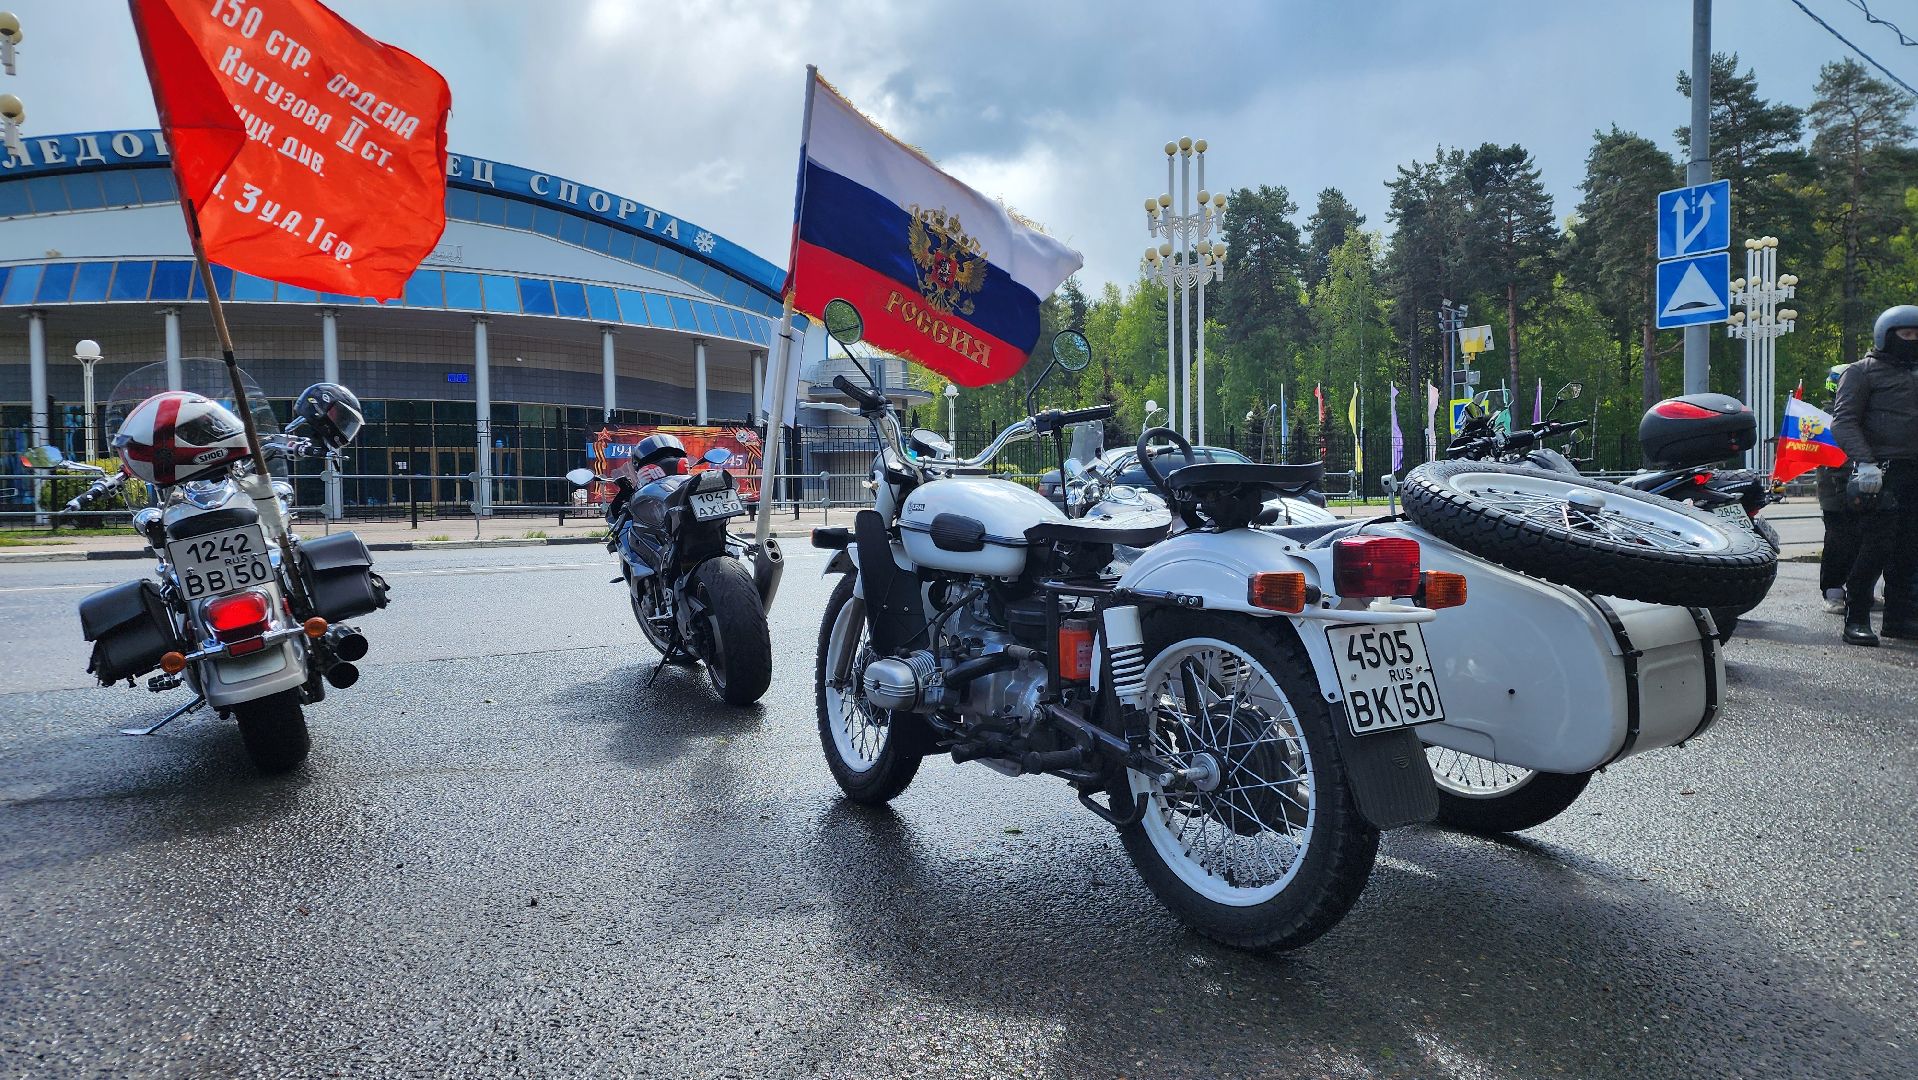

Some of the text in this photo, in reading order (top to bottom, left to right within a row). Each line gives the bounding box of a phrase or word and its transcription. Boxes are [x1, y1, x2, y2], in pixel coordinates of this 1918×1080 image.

[210, 0, 263, 39] 150
[326, 73, 420, 141] ОРДЕНА
[446, 155, 495, 188] ЕЦ
[529, 174, 680, 240] СПОРТА
[884, 289, 992, 368] РОССИЯ
[198, 449, 225, 463] SHOEI
[611, 445, 633, 457] 194
[697, 490, 730, 504] 1047
[699, 505, 719, 517] АХ
[722, 502, 739, 513] 50
[1719, 505, 1742, 518] 2843
[1739, 518, 1751, 529] 50
[186, 533, 252, 564] 1242
[224, 554, 249, 566] RUS
[184, 560, 268, 597] ВВ 50
[1347, 629, 1414, 670] 4505
[1388, 667, 1414, 682] RUS
[1349, 681, 1436, 728] ВК 50
